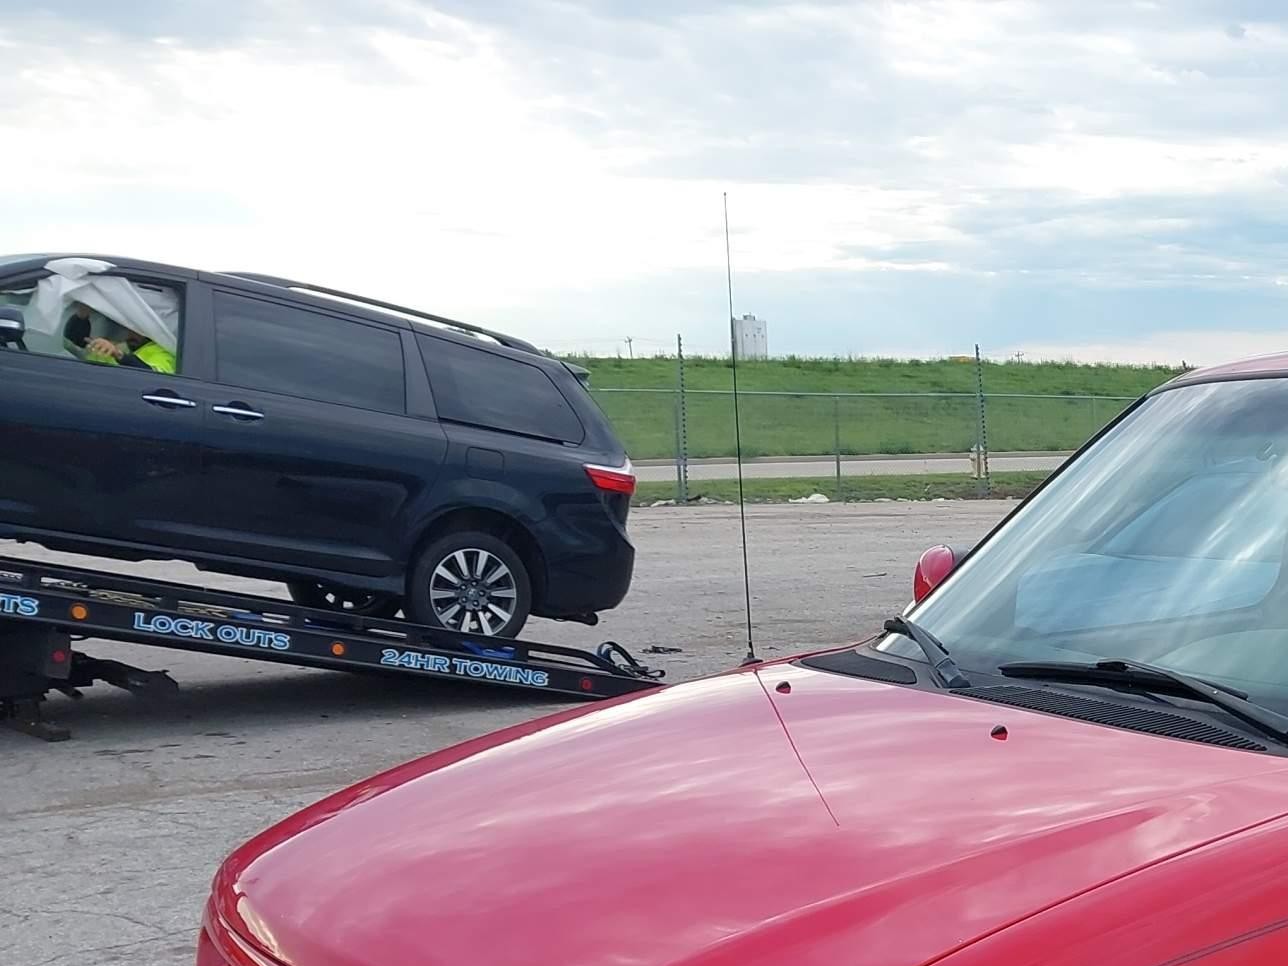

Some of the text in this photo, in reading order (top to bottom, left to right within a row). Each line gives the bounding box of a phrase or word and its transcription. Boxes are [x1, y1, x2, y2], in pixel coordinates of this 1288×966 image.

[133, 611, 290, 651] LOCK OUTS
[380, 647, 549, 687] 24HR TOWING
